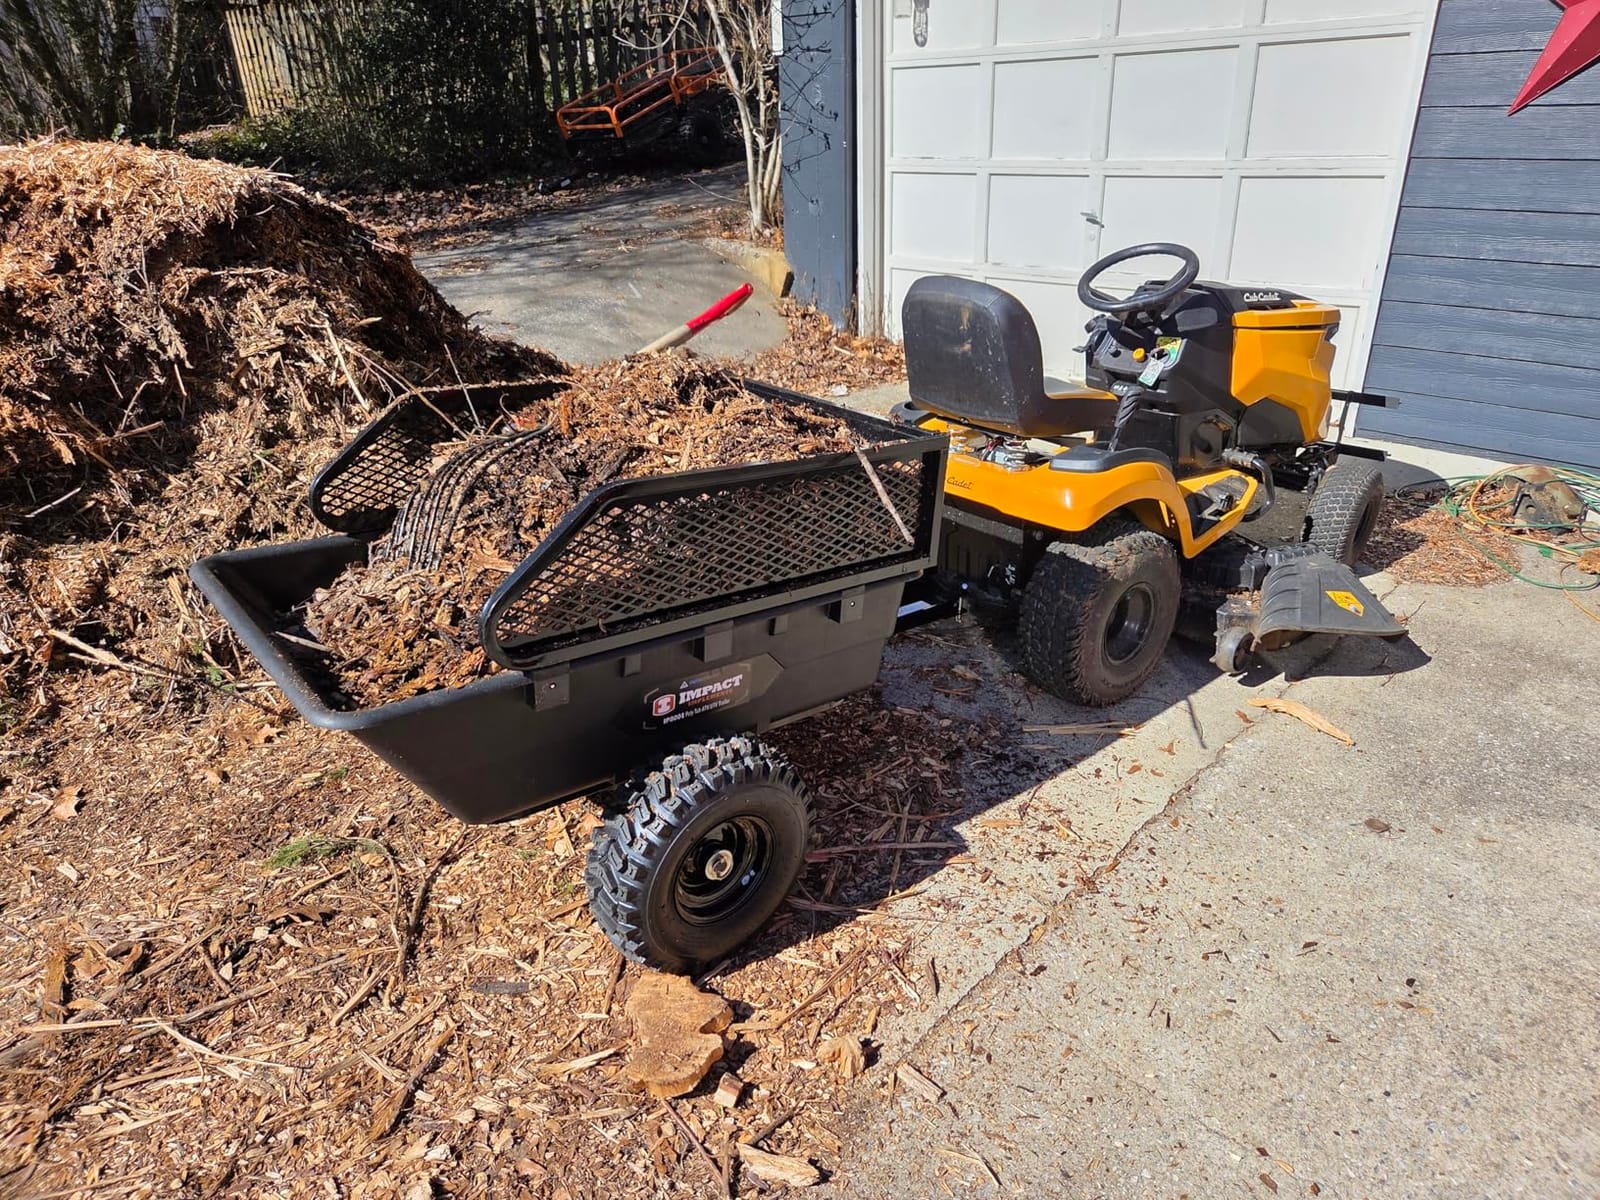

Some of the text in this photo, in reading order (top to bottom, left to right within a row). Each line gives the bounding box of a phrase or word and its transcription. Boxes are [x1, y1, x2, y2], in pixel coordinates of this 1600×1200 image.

[1243, 292, 1258, 302] Cub
[947, 477, 973, 490] Cadet
[679, 674, 743, 705] IMPACT
